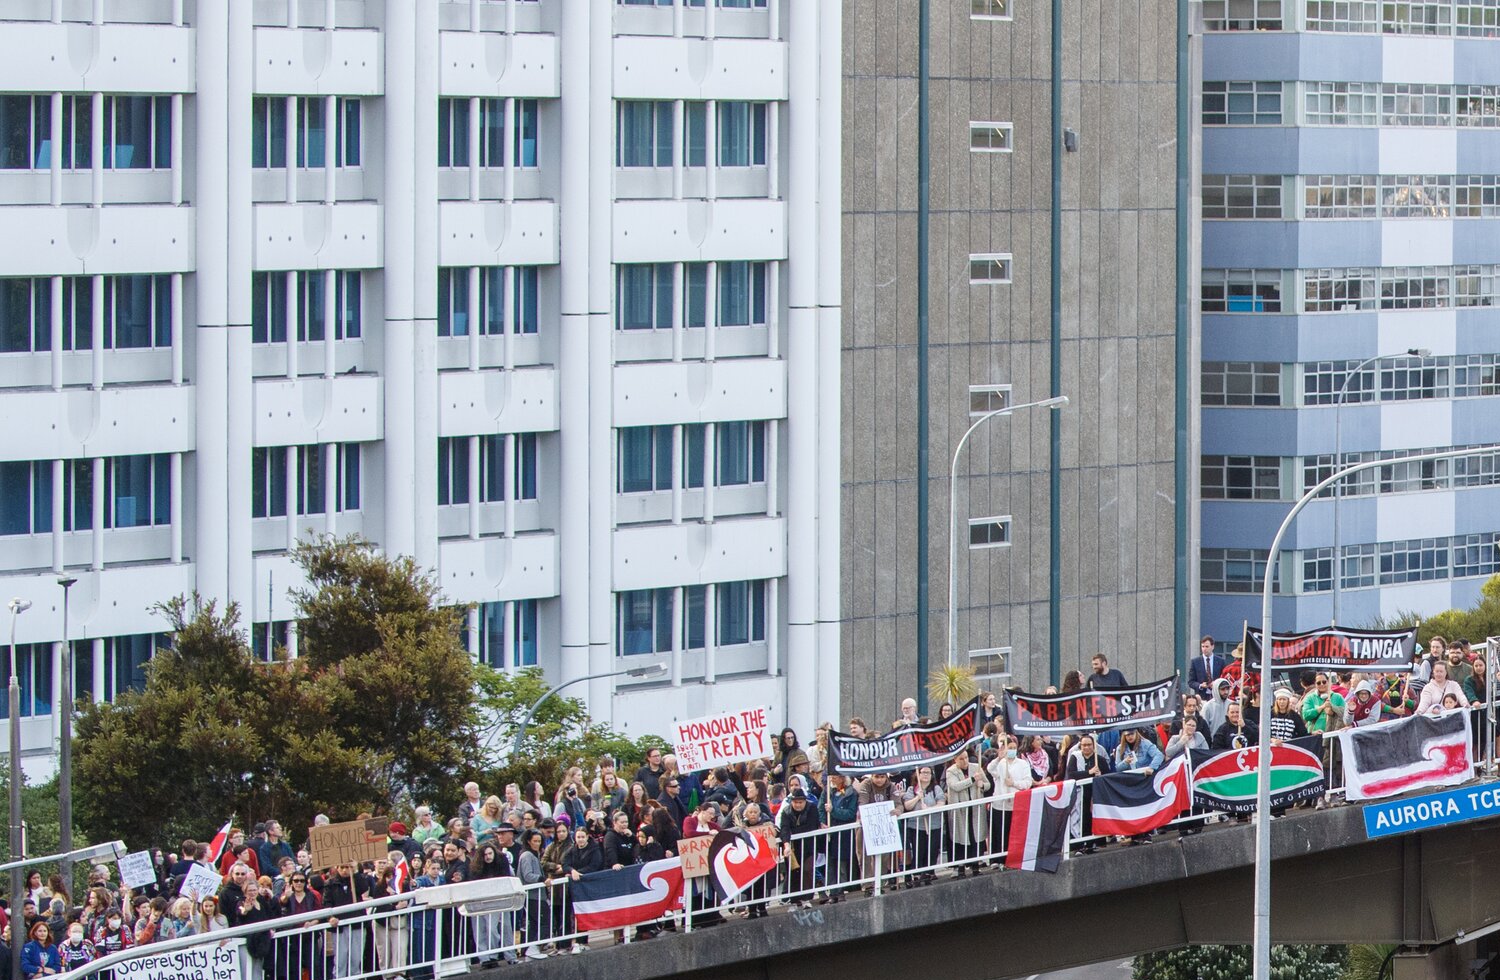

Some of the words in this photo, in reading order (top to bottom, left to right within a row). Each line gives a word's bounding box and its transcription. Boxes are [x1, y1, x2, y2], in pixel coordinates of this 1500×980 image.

[1272, 636, 1404, 660] ANGATIRATANGA
[1016, 687, 1169, 721] PARTNERSHIP
[679, 716, 740, 742] HONOUR
[740, 708, 767, 731] THE
[840, 738, 898, 760] HONOUR
[900, 731, 929, 753] THE
[925, 711, 975, 751] TREATY
[698, 729, 764, 761] TREATY
[1194, 796, 1205, 804] TE
[1208, 800, 1232, 811] MANA
[1376, 798, 1461, 829] AURORA
[314, 826, 365, 850] HONOUR
[314, 848, 331, 867] TE
[685, 858, 695, 871] 4
[212, 947, 237, 966] for
[211, 965, 237, 980] her
